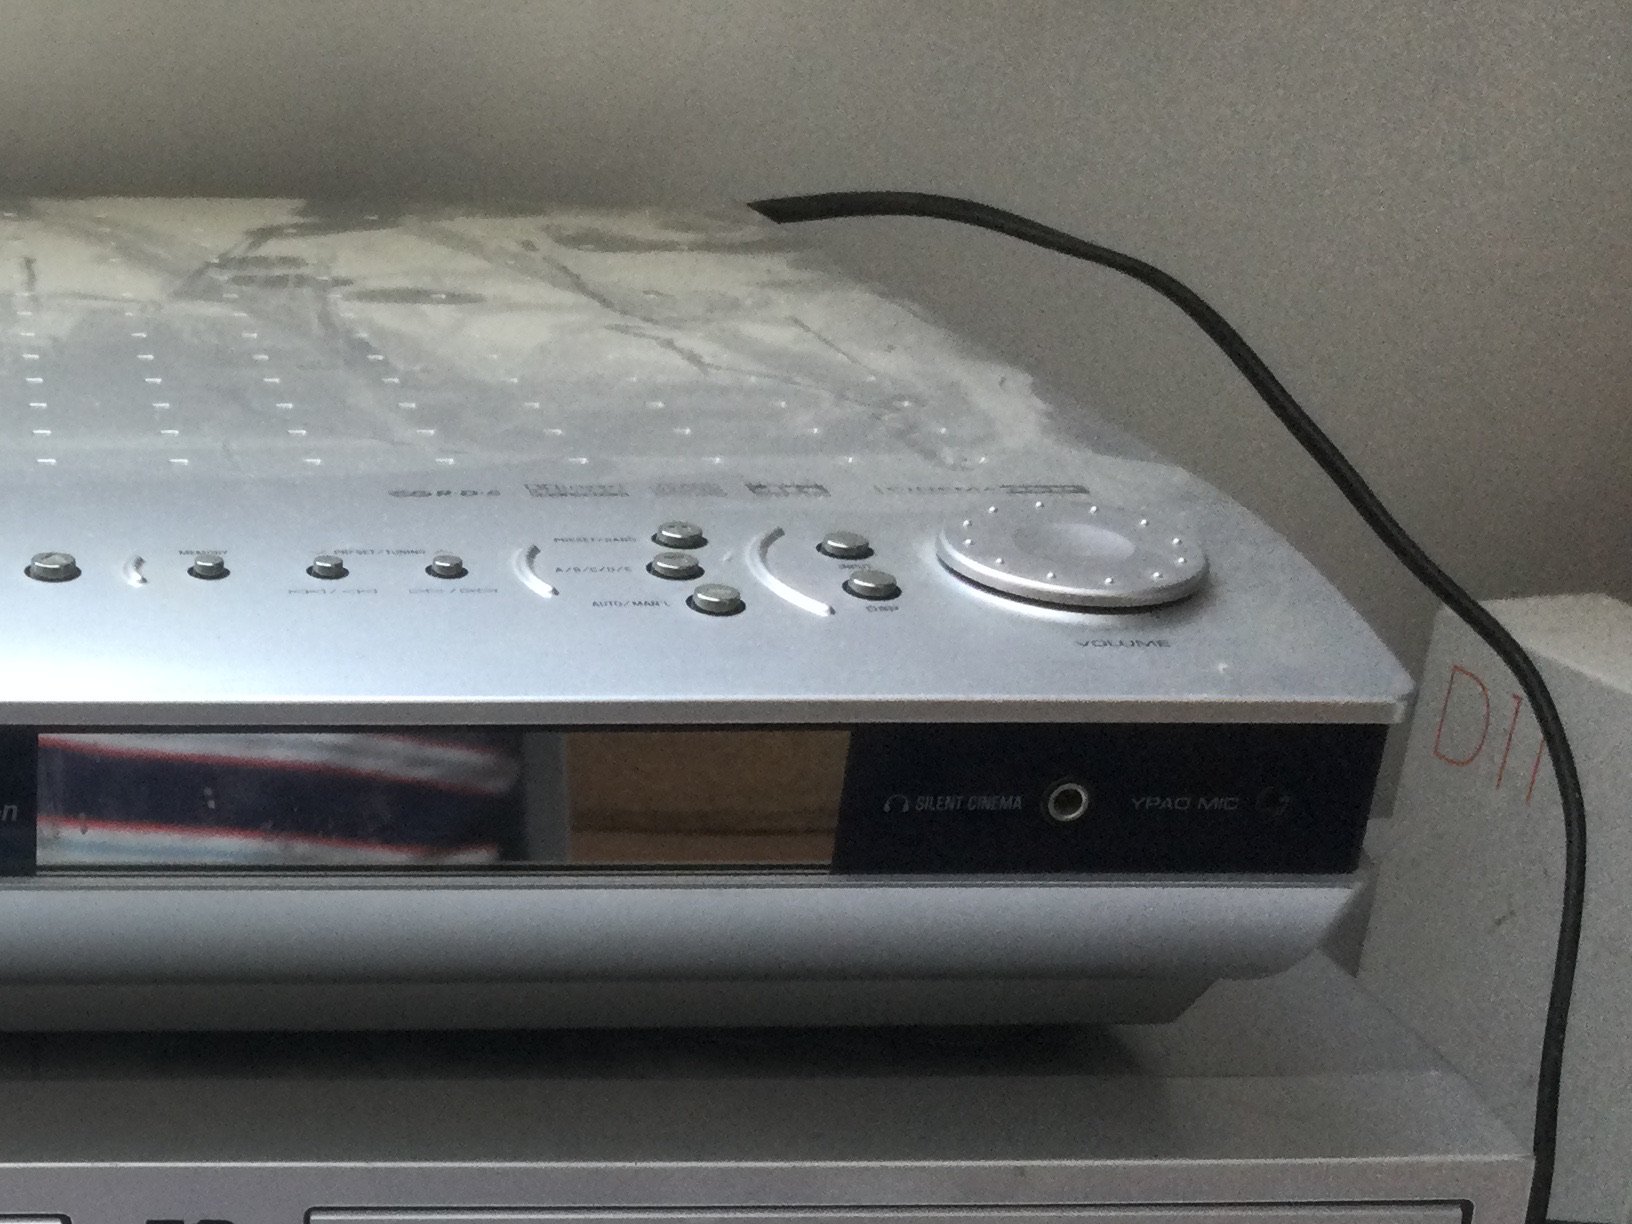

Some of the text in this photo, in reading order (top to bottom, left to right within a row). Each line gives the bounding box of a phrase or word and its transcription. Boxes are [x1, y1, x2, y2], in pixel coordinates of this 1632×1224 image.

[1074, 638, 1172, 649] VOLUME
[915, 795, 1023, 812] SILENT CINEMA
